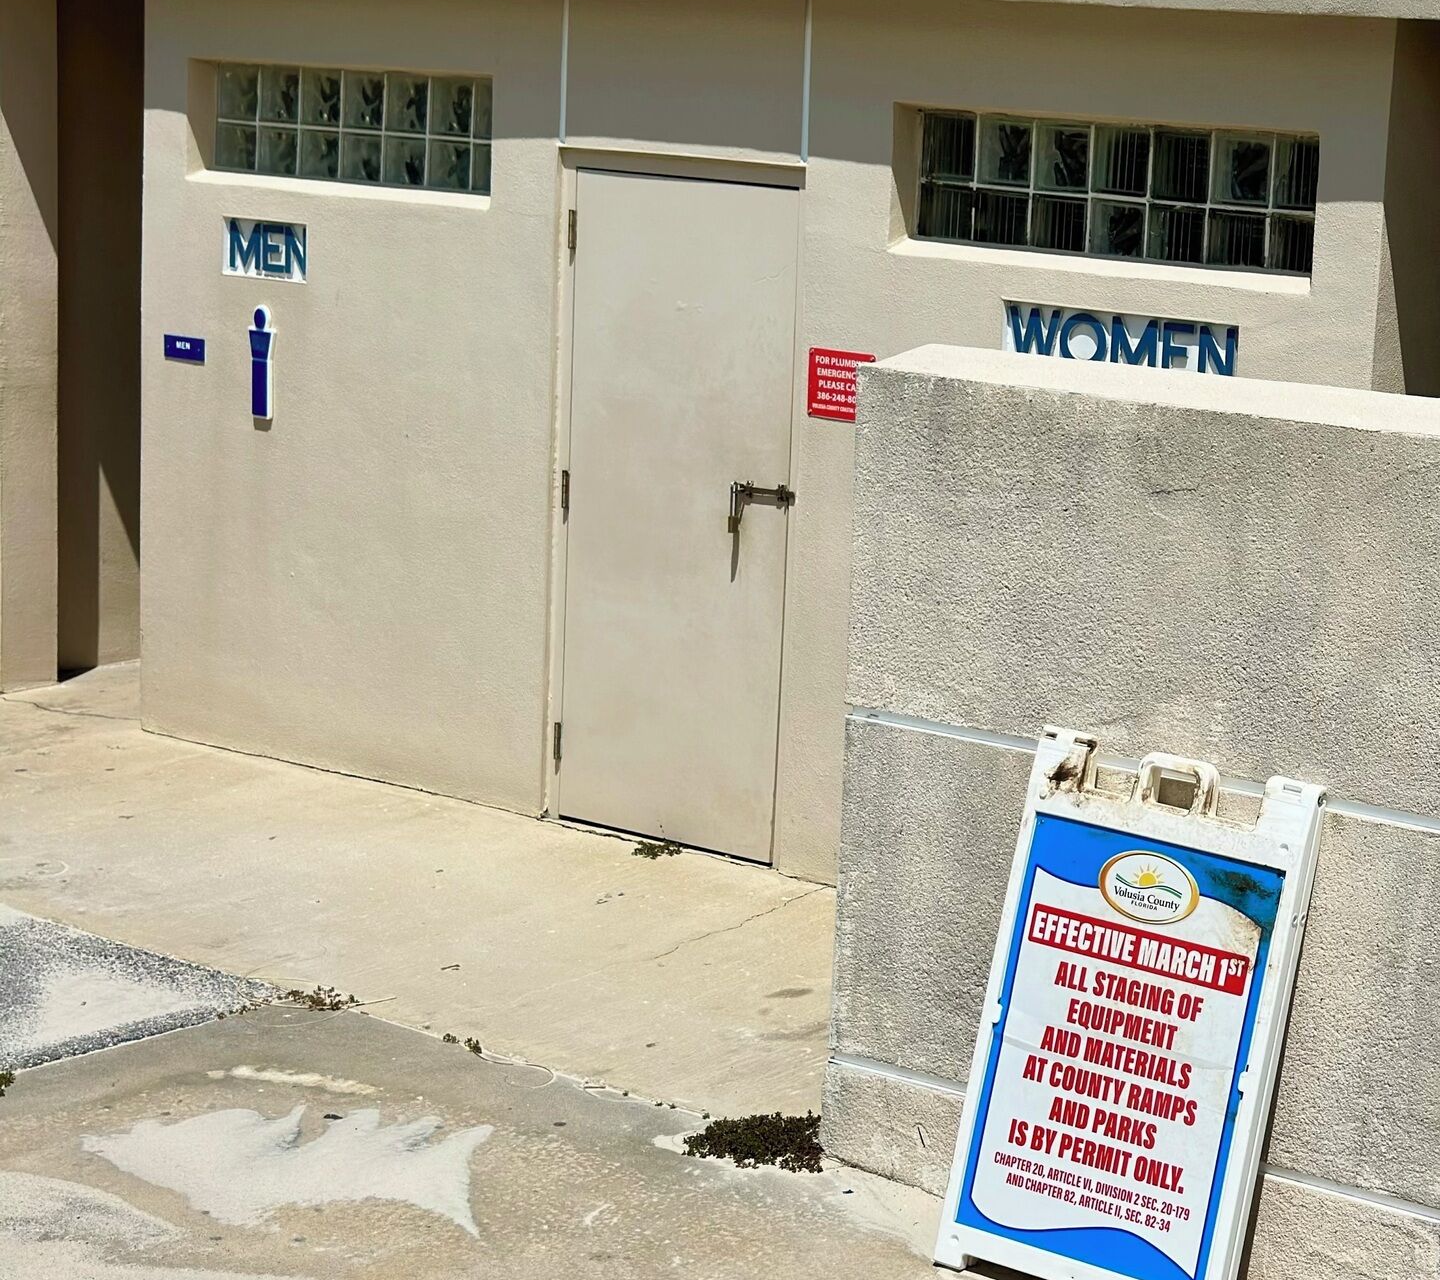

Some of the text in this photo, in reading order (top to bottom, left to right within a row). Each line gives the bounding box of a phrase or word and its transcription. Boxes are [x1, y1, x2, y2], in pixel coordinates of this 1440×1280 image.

[229, 218, 307, 276] MEN
[175, 340, 191, 351] MEN
[815, 355, 863, 368] FOR PLUMB
[1008, 305, 1237, 377] WOMEN
[817, 367, 857, 380] EMERGENC
[817, 391, 857, 404] 386-248-80
[818, 379, 857, 392] PLEASE CA
[1114, 885, 1180, 913] Volusia County
[1130, 900, 1158, 911] FLORIDA
[1032, 910, 1246, 987] EFFECTIVE MARCH 1ST
[1054, 961, 1204, 1022] ALL STAGING OF
[1066, 998, 1178, 1051] EQUIPMENT
[1040, 1025, 1192, 1090] AND MATERIALS
[1022, 1054, 1198, 1127] AT COUNTY RAMPS
[1049, 1096, 1157, 1150] AND PARKS
[1008, 1118, 1185, 1194] IS BY PERMIT ONLY.
[994, 1151, 1190, 1221] CHAPTER 20, ARTICLE VI, DIVISION 2 SEC. 20-179
[1005, 1172, 1171, 1233] AND CHAPTER 82, ARTICLE II, SEC. 82-34
